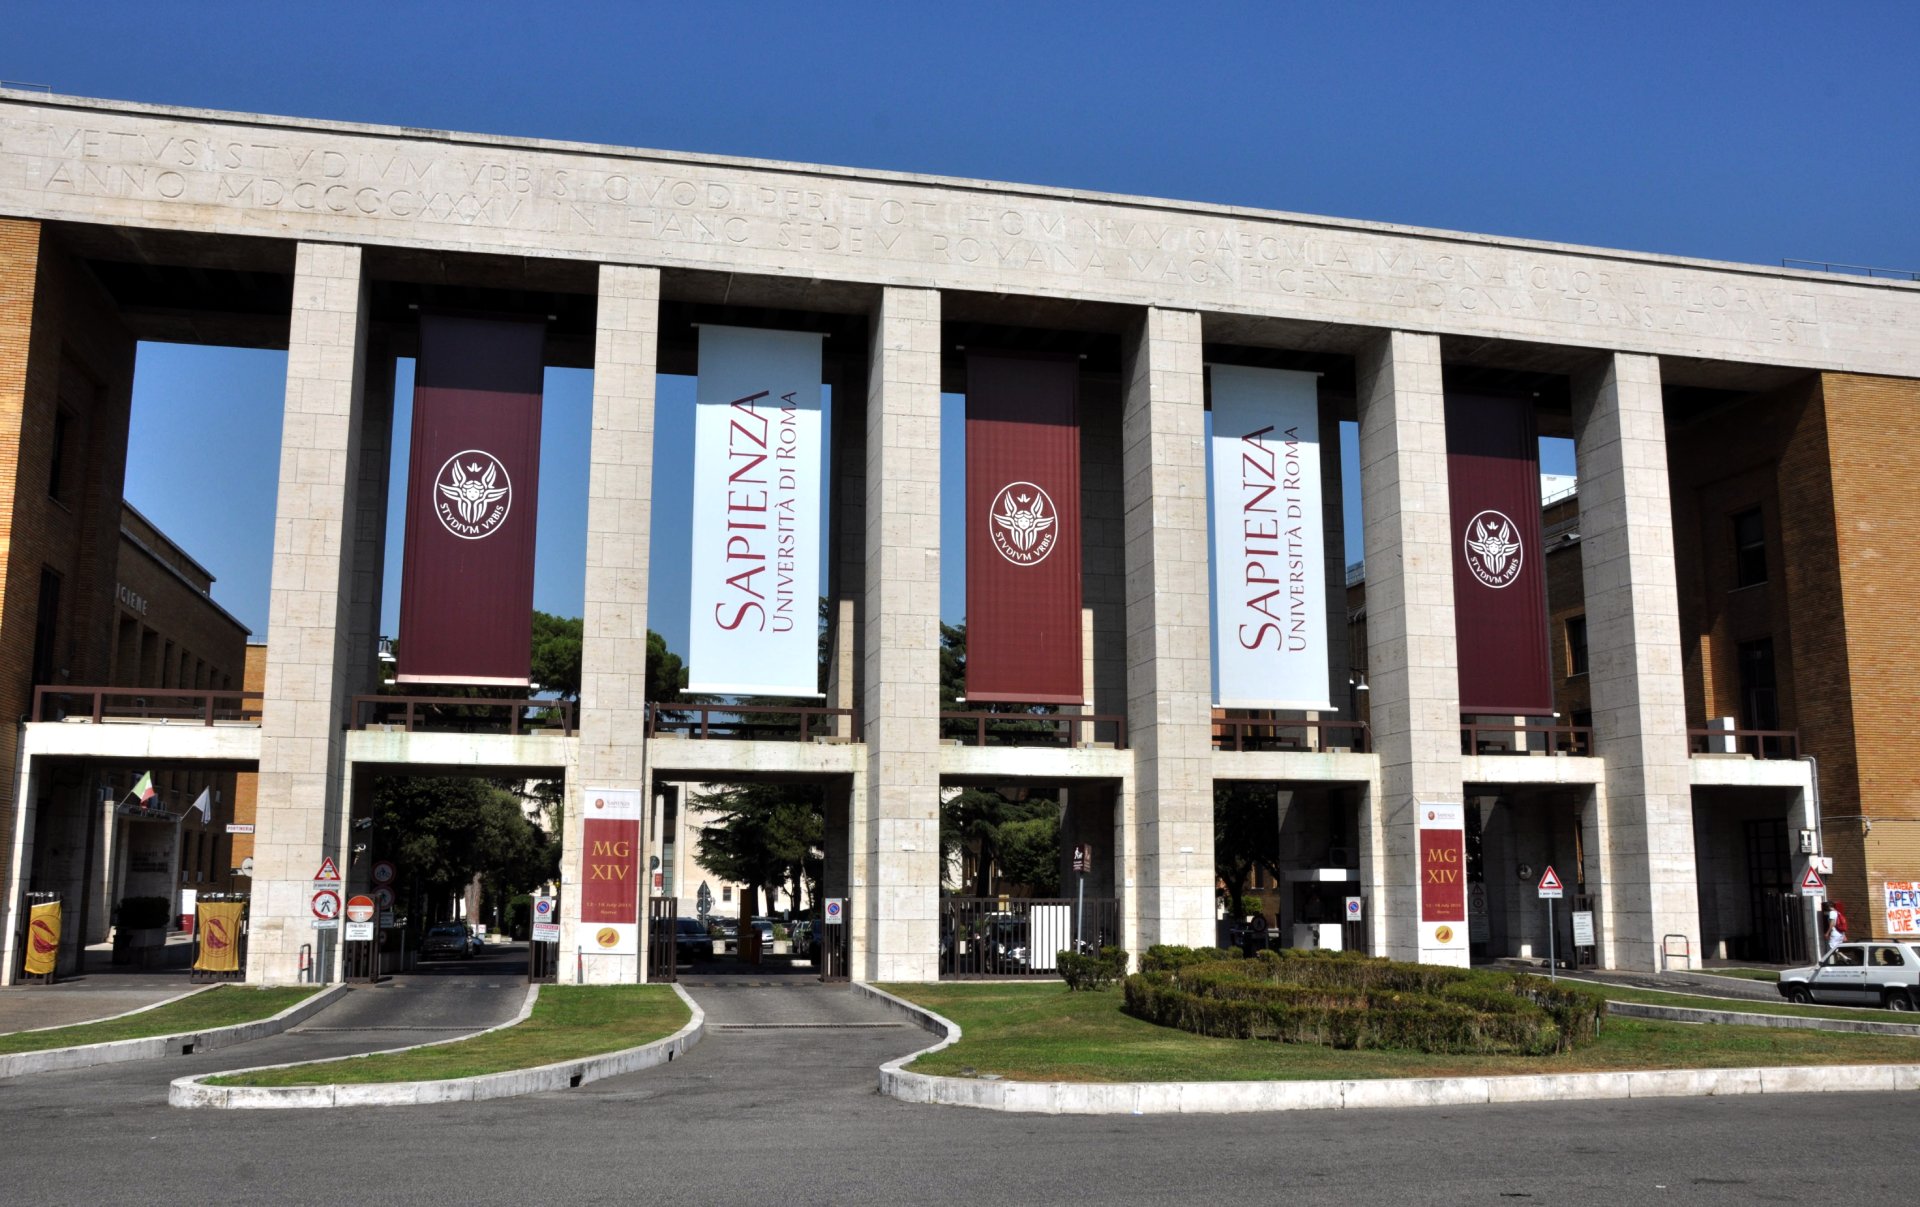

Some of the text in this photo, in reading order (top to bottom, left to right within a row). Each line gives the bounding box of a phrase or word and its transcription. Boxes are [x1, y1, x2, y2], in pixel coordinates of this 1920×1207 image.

[48, 125, 199, 166] VETVS
[225, 142, 434, 188] STVDIVM
[459, 161, 569, 197] VRBIS
[1194, 229, 1343, 268] SAECVLA
[1372, 249, 1508, 286] MAGNA
[44, 161, 187, 200] ANNO
[215, 174, 522, 225] MDCCCCXXXV
[555, 201, 596, 233] IN
[628, 206, 749, 244] HANC
[777, 220, 906, 258] SEDEM
[931, 234, 1107, 276] ROMANA
[1768, 316, 1819, 350] EST
[776, 391, 798, 460] ROMA
[1283, 426, 1300, 490] ROMA
[778, 468, 797, 491] DI
[440, 502, 504, 534] STVDIVM VRBIS
[715, 389, 770, 632] SAPIENZA
[1286, 497, 1303, 519] DI
[995, 531, 1052, 561] STVDIVM VRBIS
[1239, 425, 1282, 651] SAPIENZA
[1470, 556, 1519, 584] STVDIVM VRBIS
[592, 841, 630, 857] MG
[1427, 848, 1457, 863] MG
[590, 864, 631, 881] XIV
[1427, 869, 1458, 884] XIV
[1892, 919, 1914, 932] LIVE
